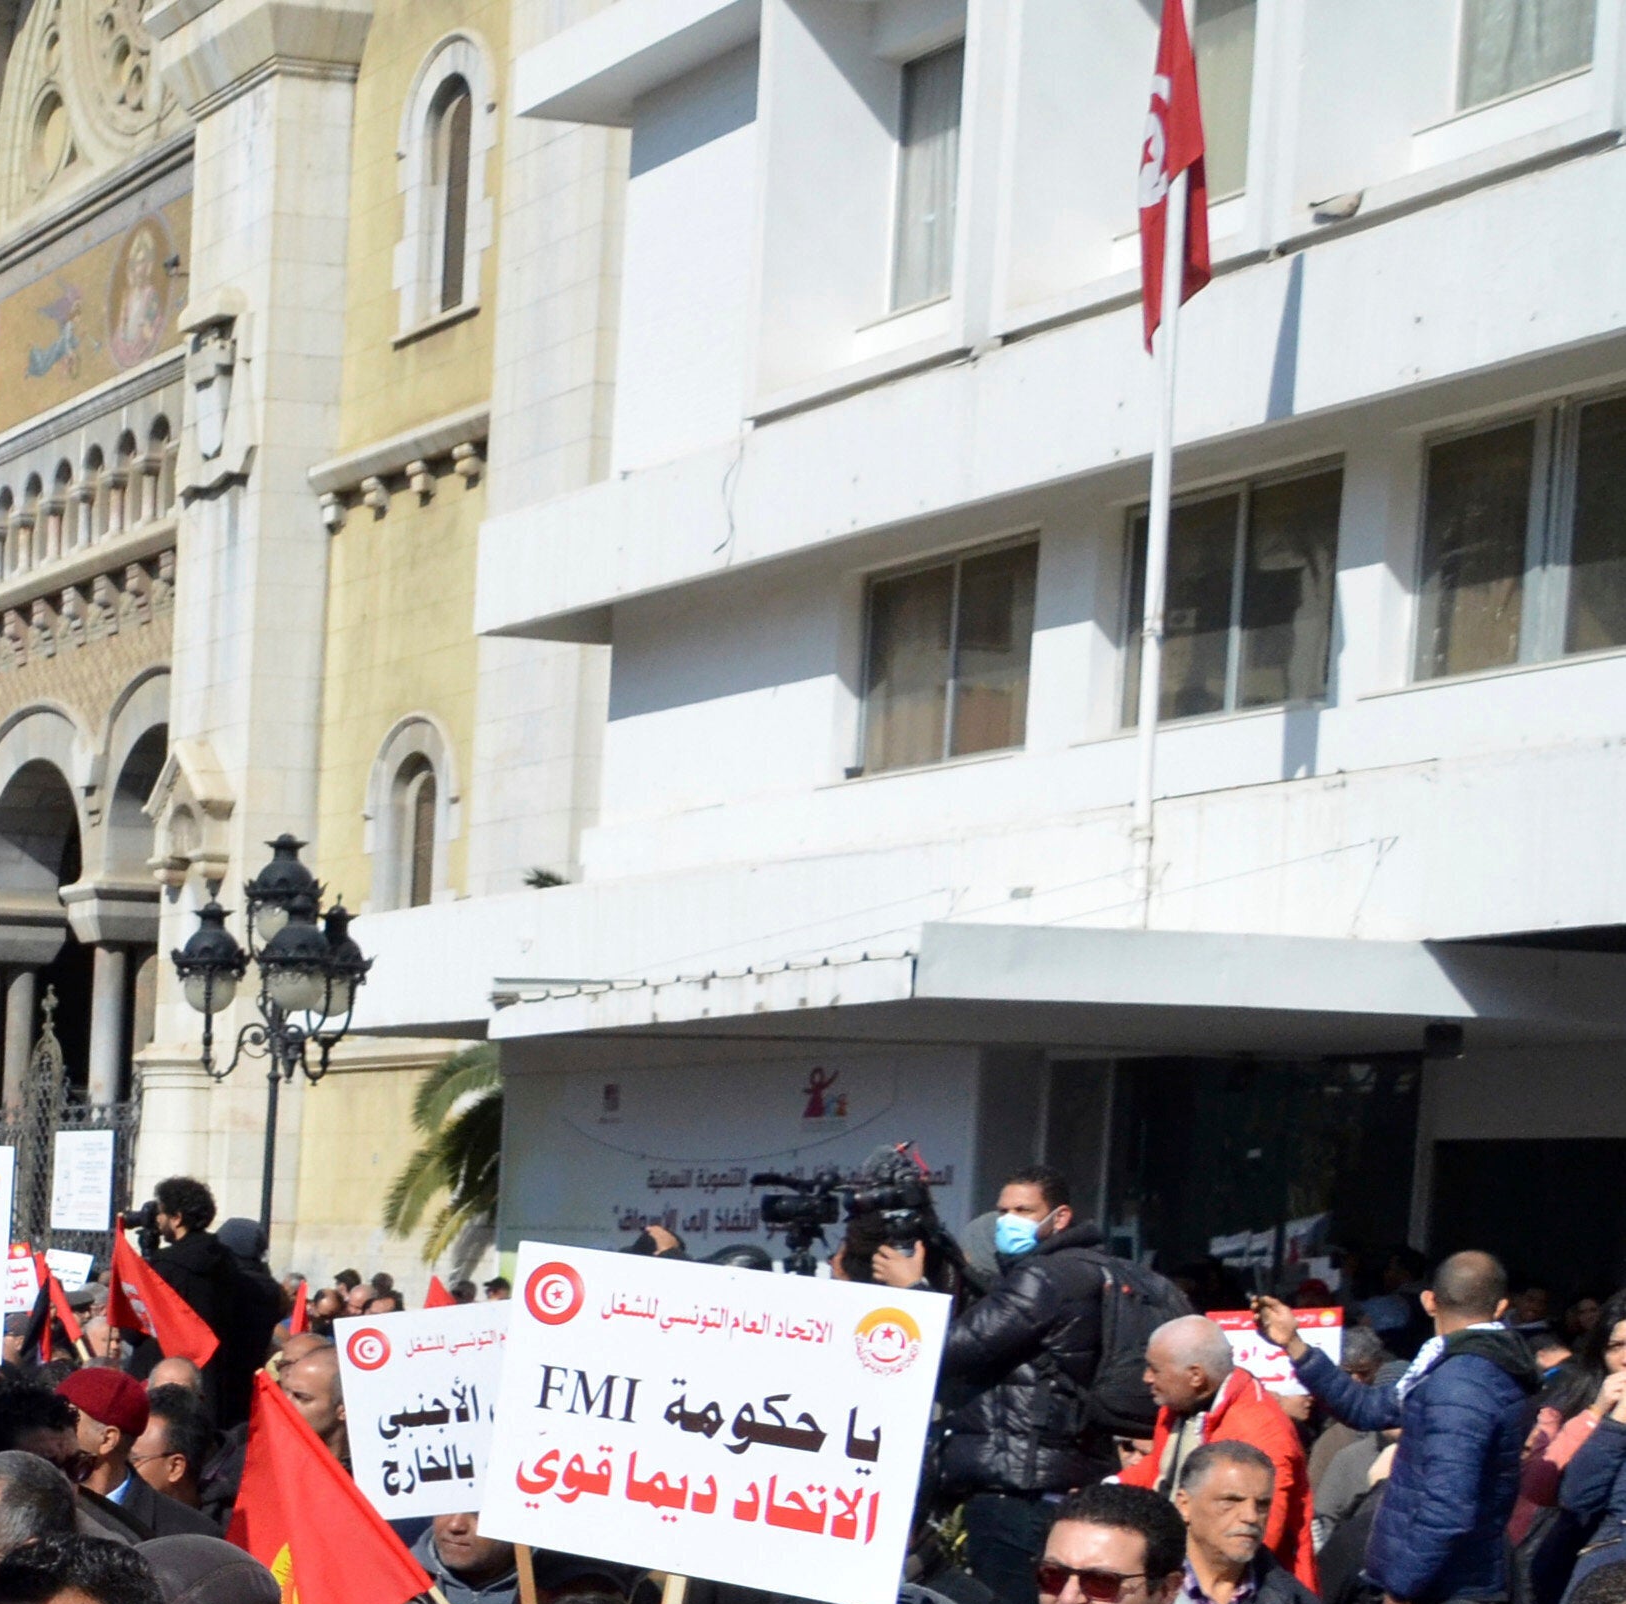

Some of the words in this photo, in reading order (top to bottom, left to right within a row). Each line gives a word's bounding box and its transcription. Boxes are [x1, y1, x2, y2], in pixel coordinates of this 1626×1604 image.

[601, 1292, 659, 1320] للشغل
[659, 1303, 729, 1334] التونسي
[729, 1310, 770, 1341] العام
[774, 1319, 834, 1344] الاتحاد
[378, 1376, 480, 1449] الأجنبي
[534, 1363, 642, 1424] FMI
[663, 1377, 828, 1454] حكومة
[382, 1443, 475, 1497] بالخارج
[845, 1405, 882, 1475] يا
[625, 1450, 718, 1523] ديما
[733, 1474, 880, 1545] الاتحاد
